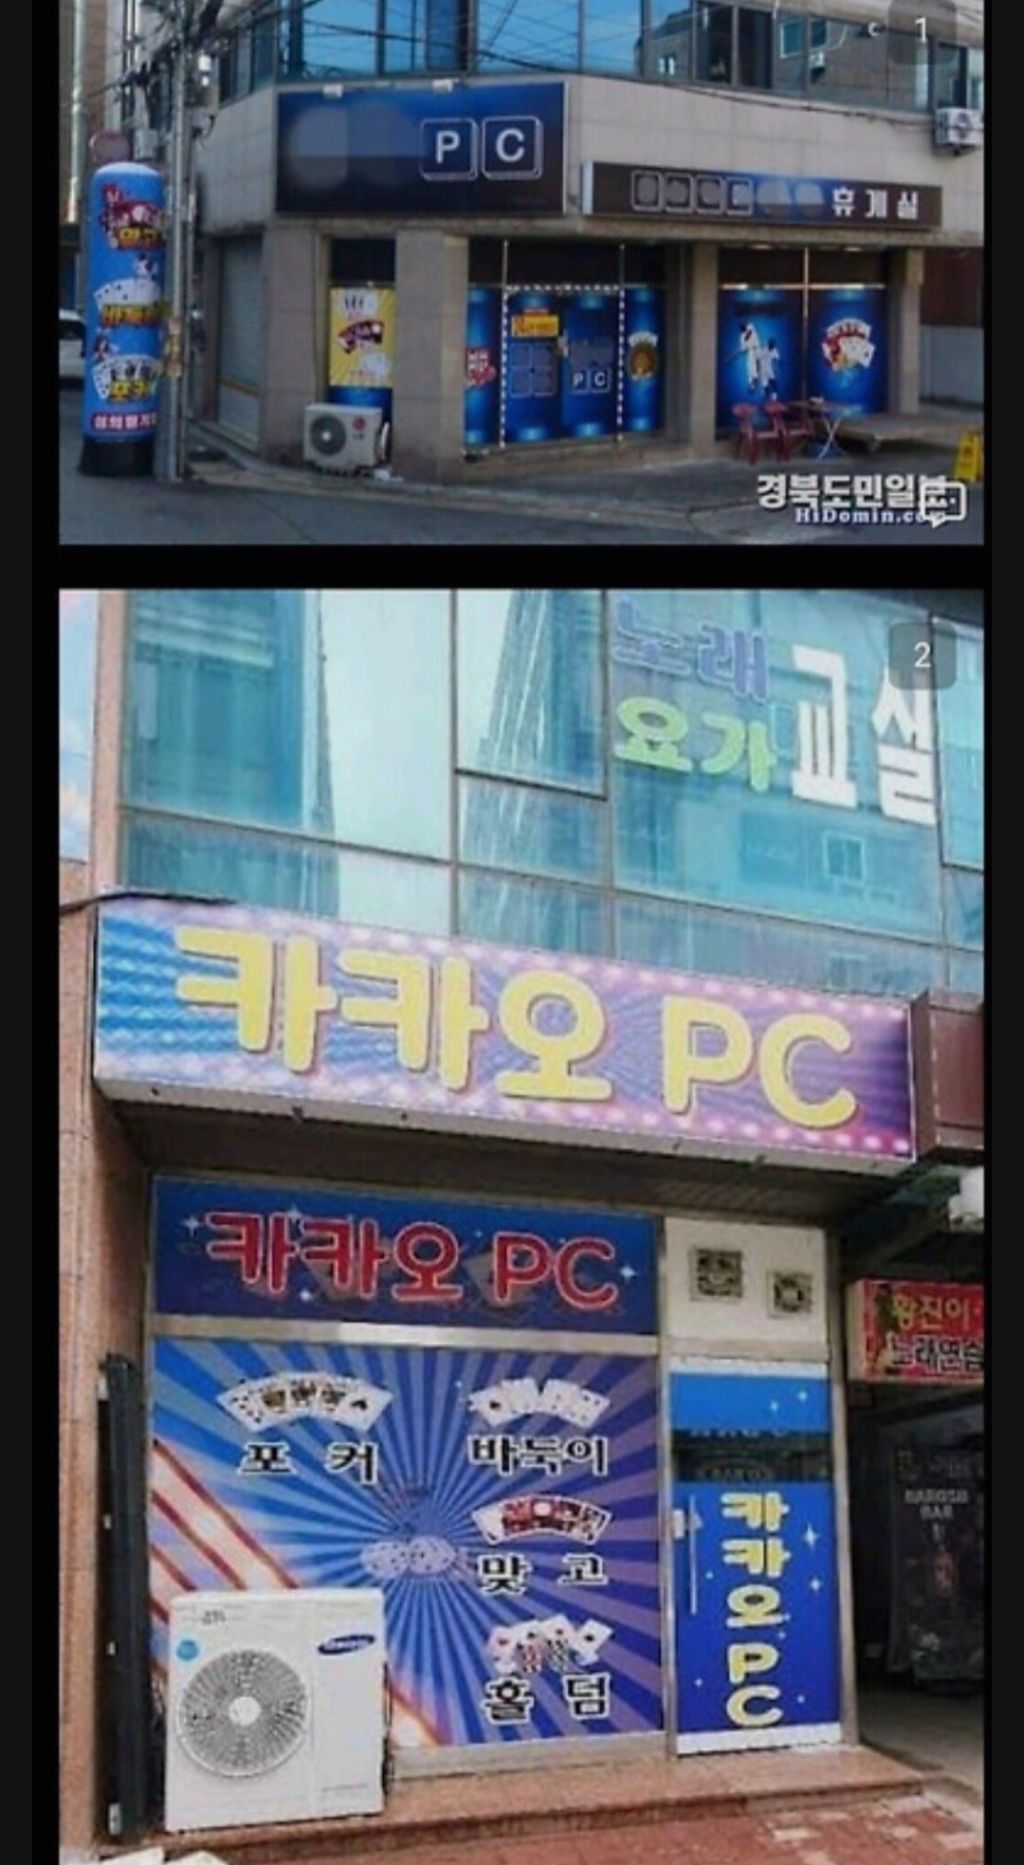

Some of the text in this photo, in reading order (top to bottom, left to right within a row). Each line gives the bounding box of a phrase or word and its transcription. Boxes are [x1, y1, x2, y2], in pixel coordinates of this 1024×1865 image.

[435, 128, 525, 164] PC
[832, 186, 919, 220] 휴게실
[612, 596, 769, 703] 노래
[614, 695, 777, 792] 요가
[791, 644, 938, 827] 교실
[175, 926, 860, 1130] 카카오 PC
[204, 1210, 619, 1312] 카카오 PC
[468, 1435, 610, 1476] 바둑이
